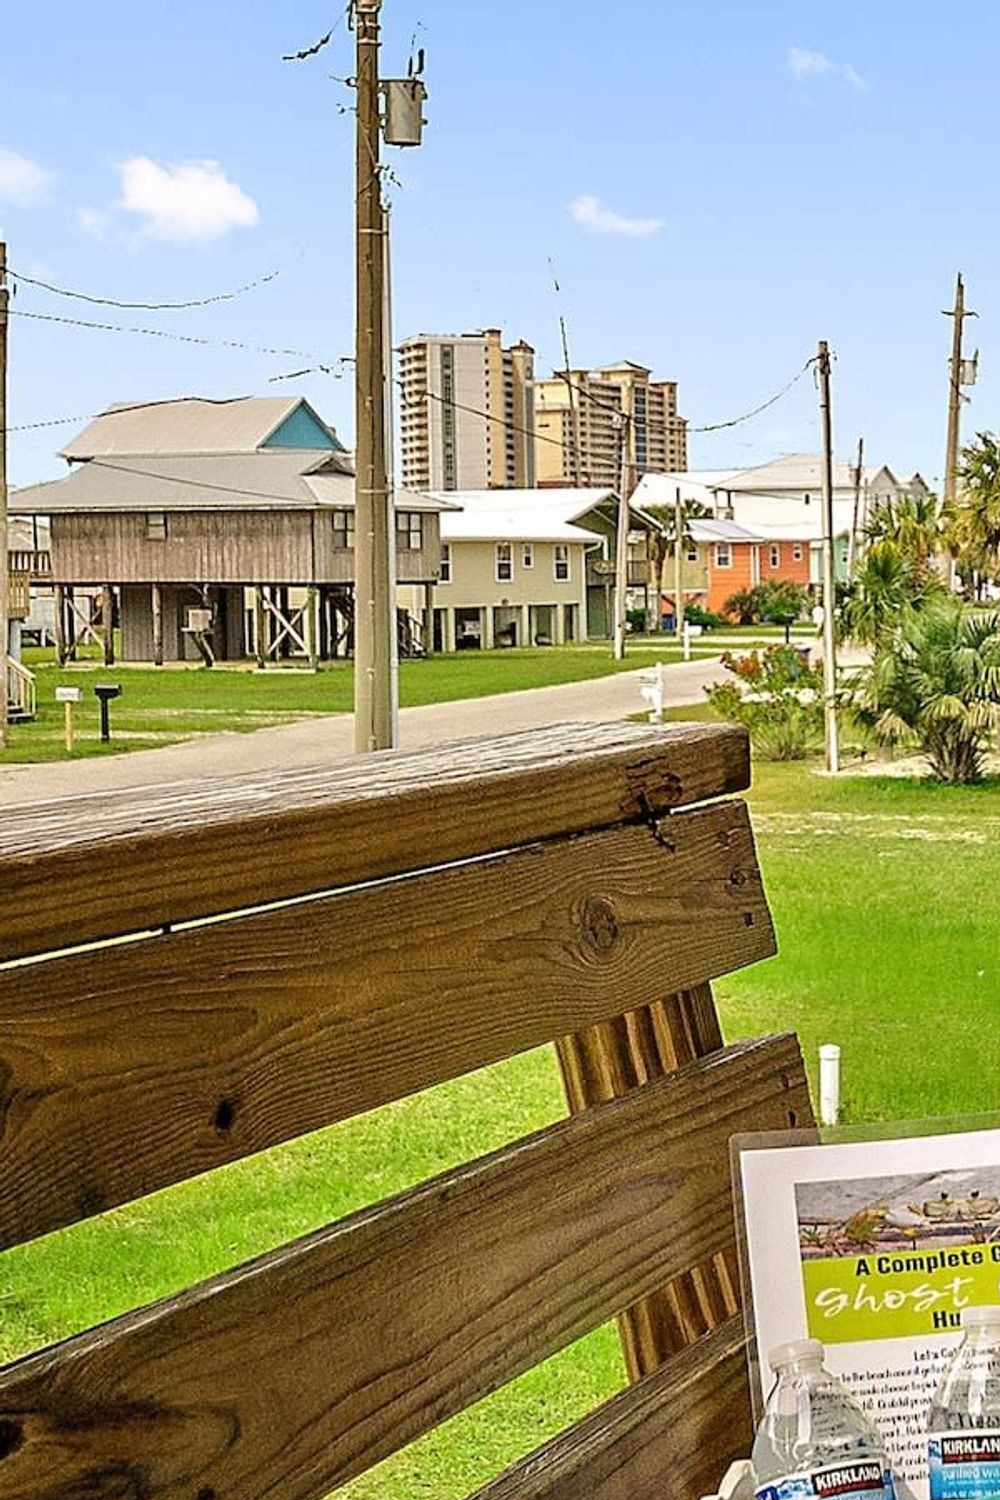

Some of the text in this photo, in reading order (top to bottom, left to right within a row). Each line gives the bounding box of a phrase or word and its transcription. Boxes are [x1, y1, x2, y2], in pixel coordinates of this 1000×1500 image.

[855, 1258, 870, 1277] A
[877, 1252, 984, 1276] Complete
[814, 1465, 881, 1491] KIRKLAND
